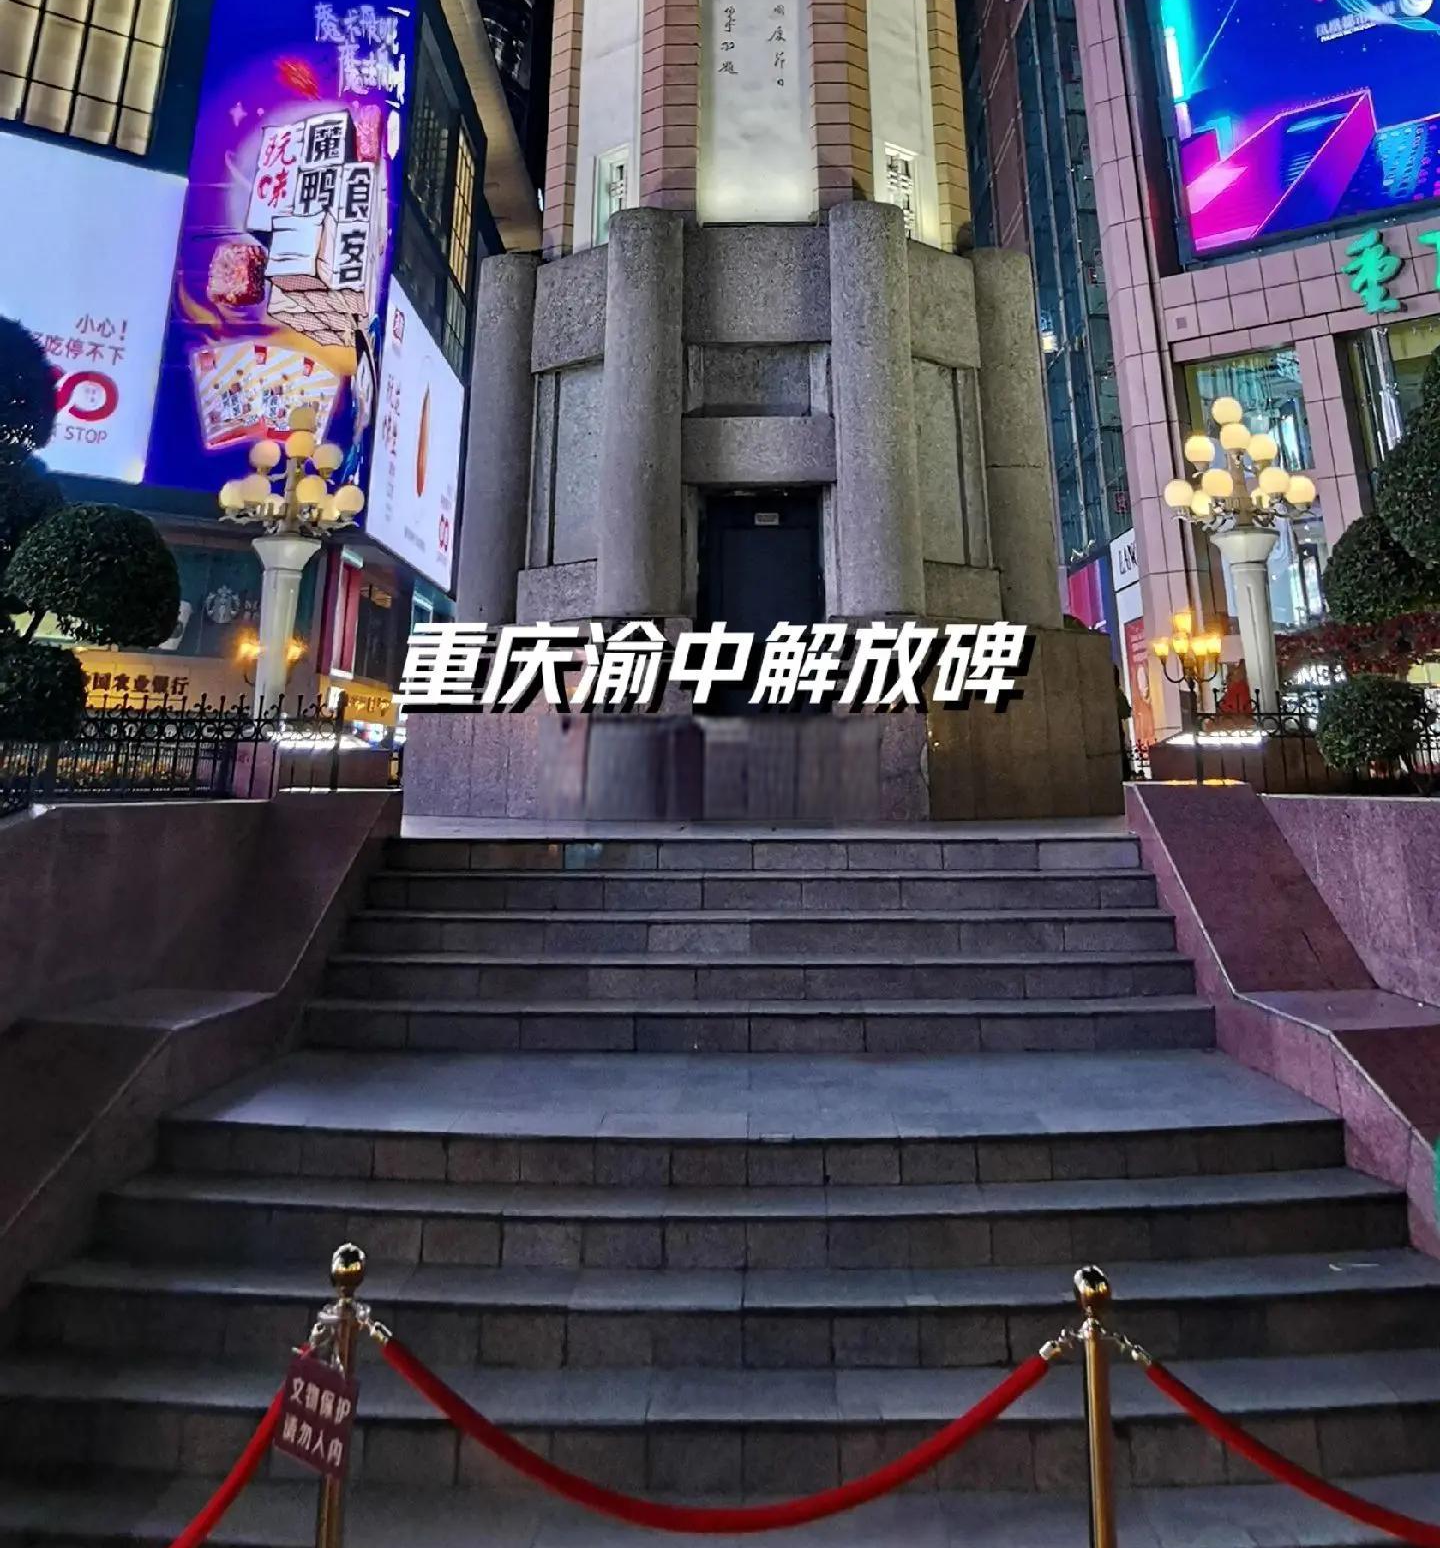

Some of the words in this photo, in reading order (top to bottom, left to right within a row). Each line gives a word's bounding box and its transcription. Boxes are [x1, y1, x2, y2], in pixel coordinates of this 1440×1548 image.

[64, 426, 107, 443] STOP
[290, 1377, 351, 1424] 文物保护
